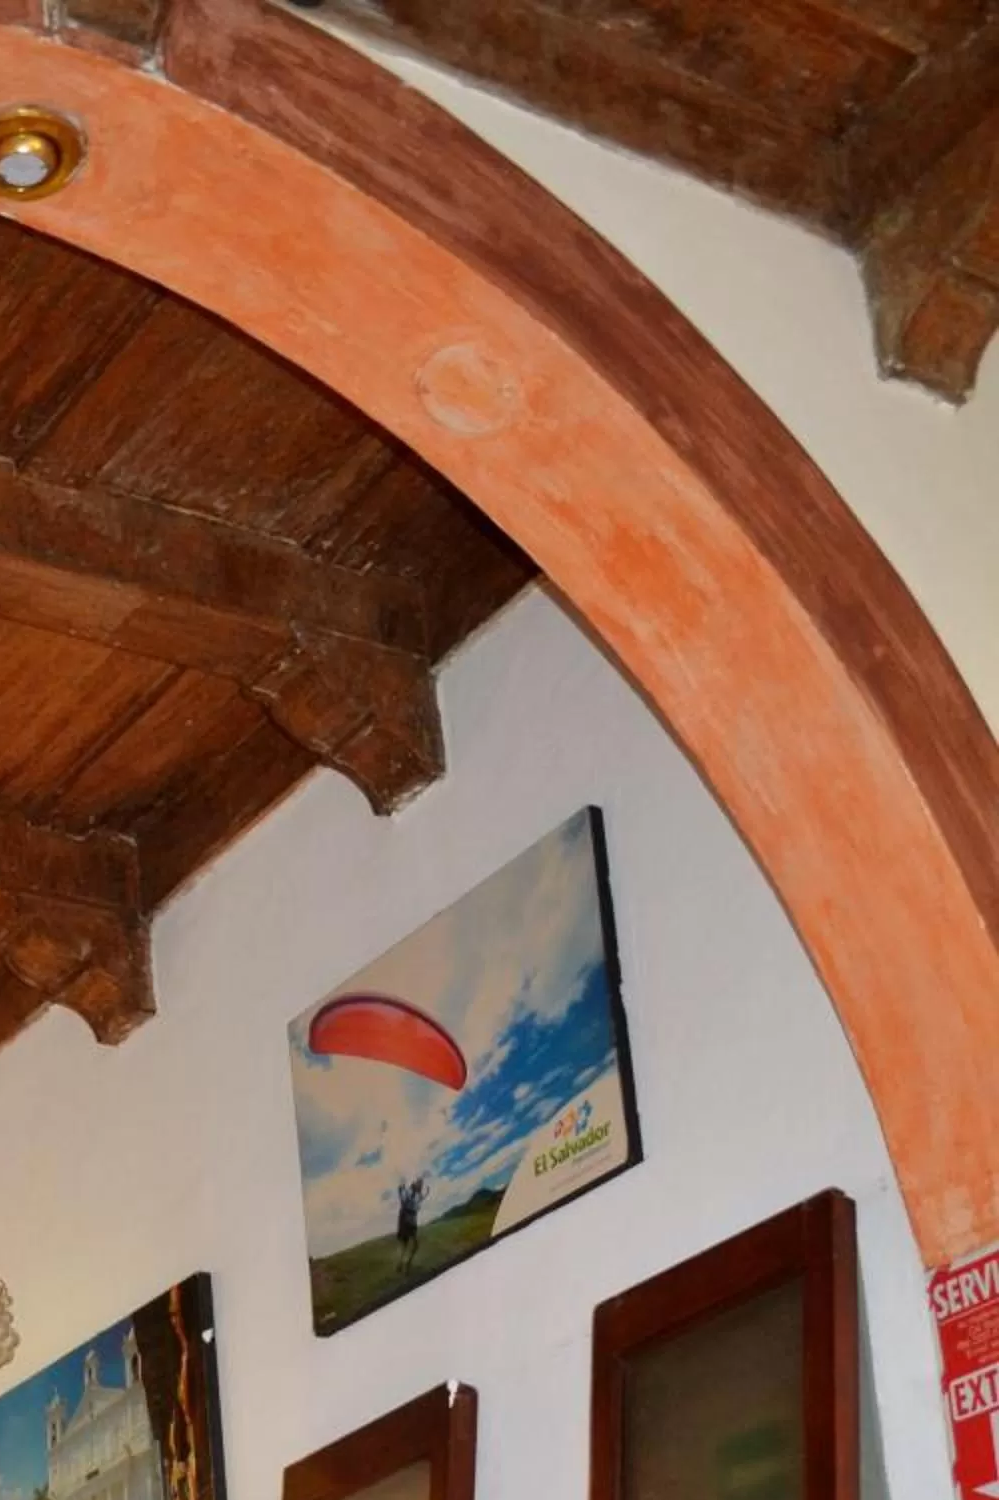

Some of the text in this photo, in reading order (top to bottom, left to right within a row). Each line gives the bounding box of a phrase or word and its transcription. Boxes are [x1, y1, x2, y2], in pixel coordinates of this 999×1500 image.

[534, 1154, 547, 1178] El
[549, 1120, 611, 1170] Salvador
[954, 1369, 999, 1416] EXT
